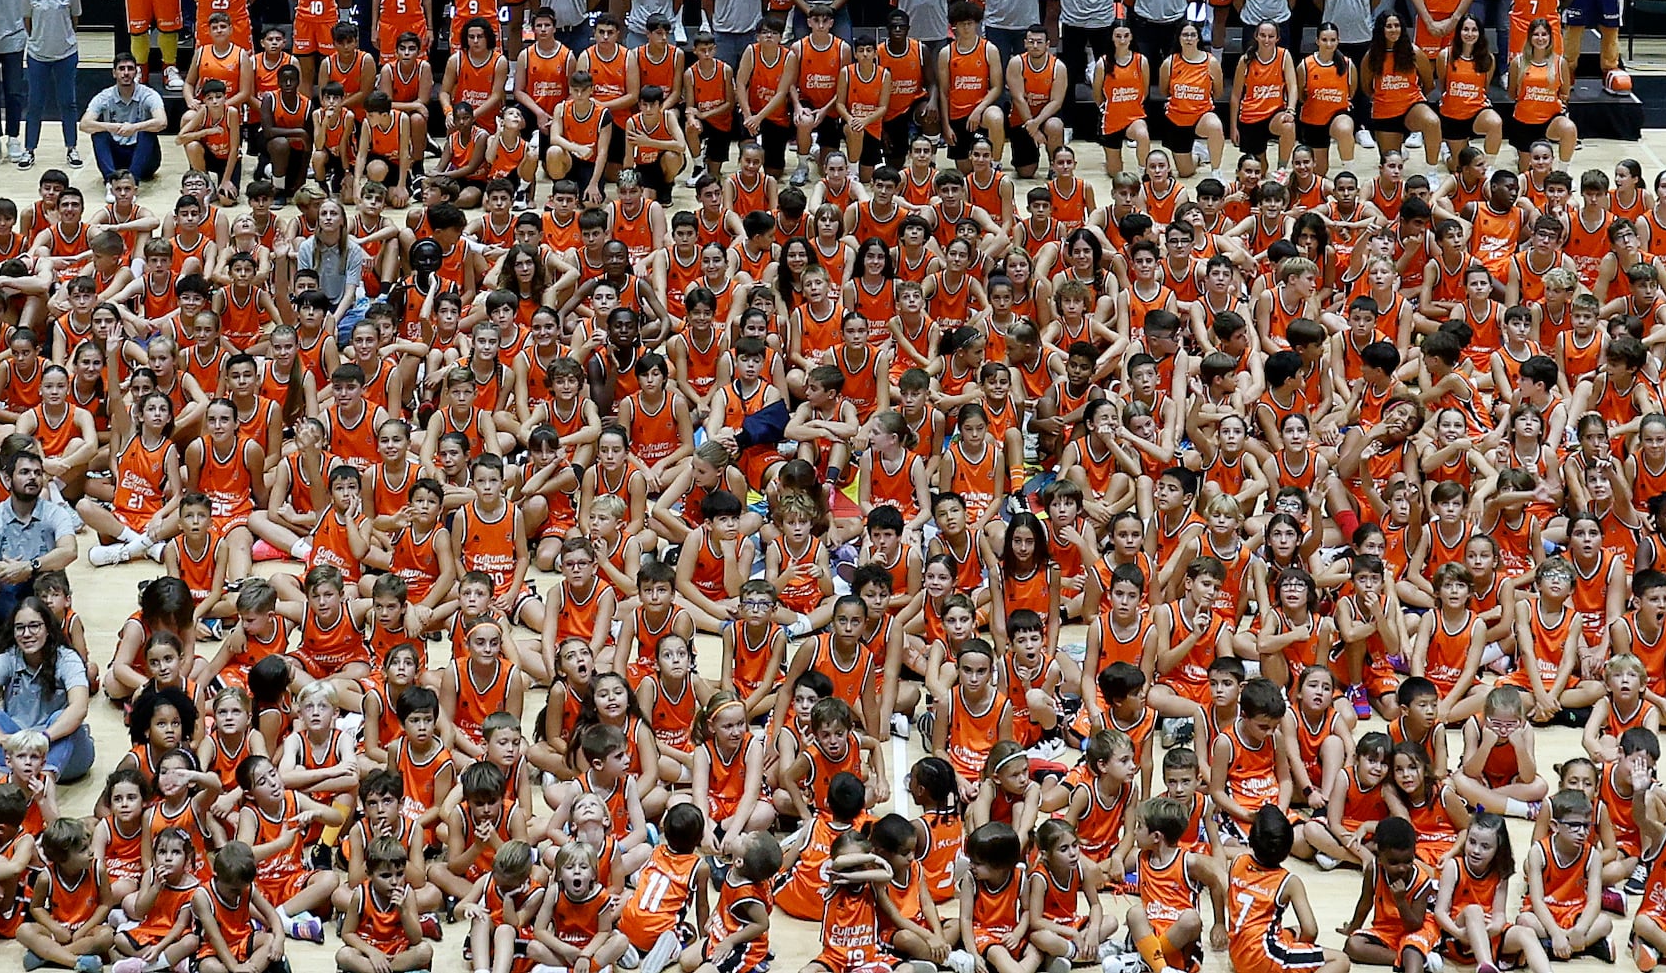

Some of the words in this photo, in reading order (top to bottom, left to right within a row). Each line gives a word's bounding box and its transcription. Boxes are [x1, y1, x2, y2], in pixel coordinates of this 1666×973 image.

[309, 1, 323, 15] 10
[397, 0, 406, 14] 5
[469, 0, 479, 14] 9
[1530, 0, 1539, 14] 7
[128, 493, 143, 508] 21
[639, 874, 671, 912] 11
[1235, 894, 1255, 934] 7
[847, 949, 865, 966] 19
